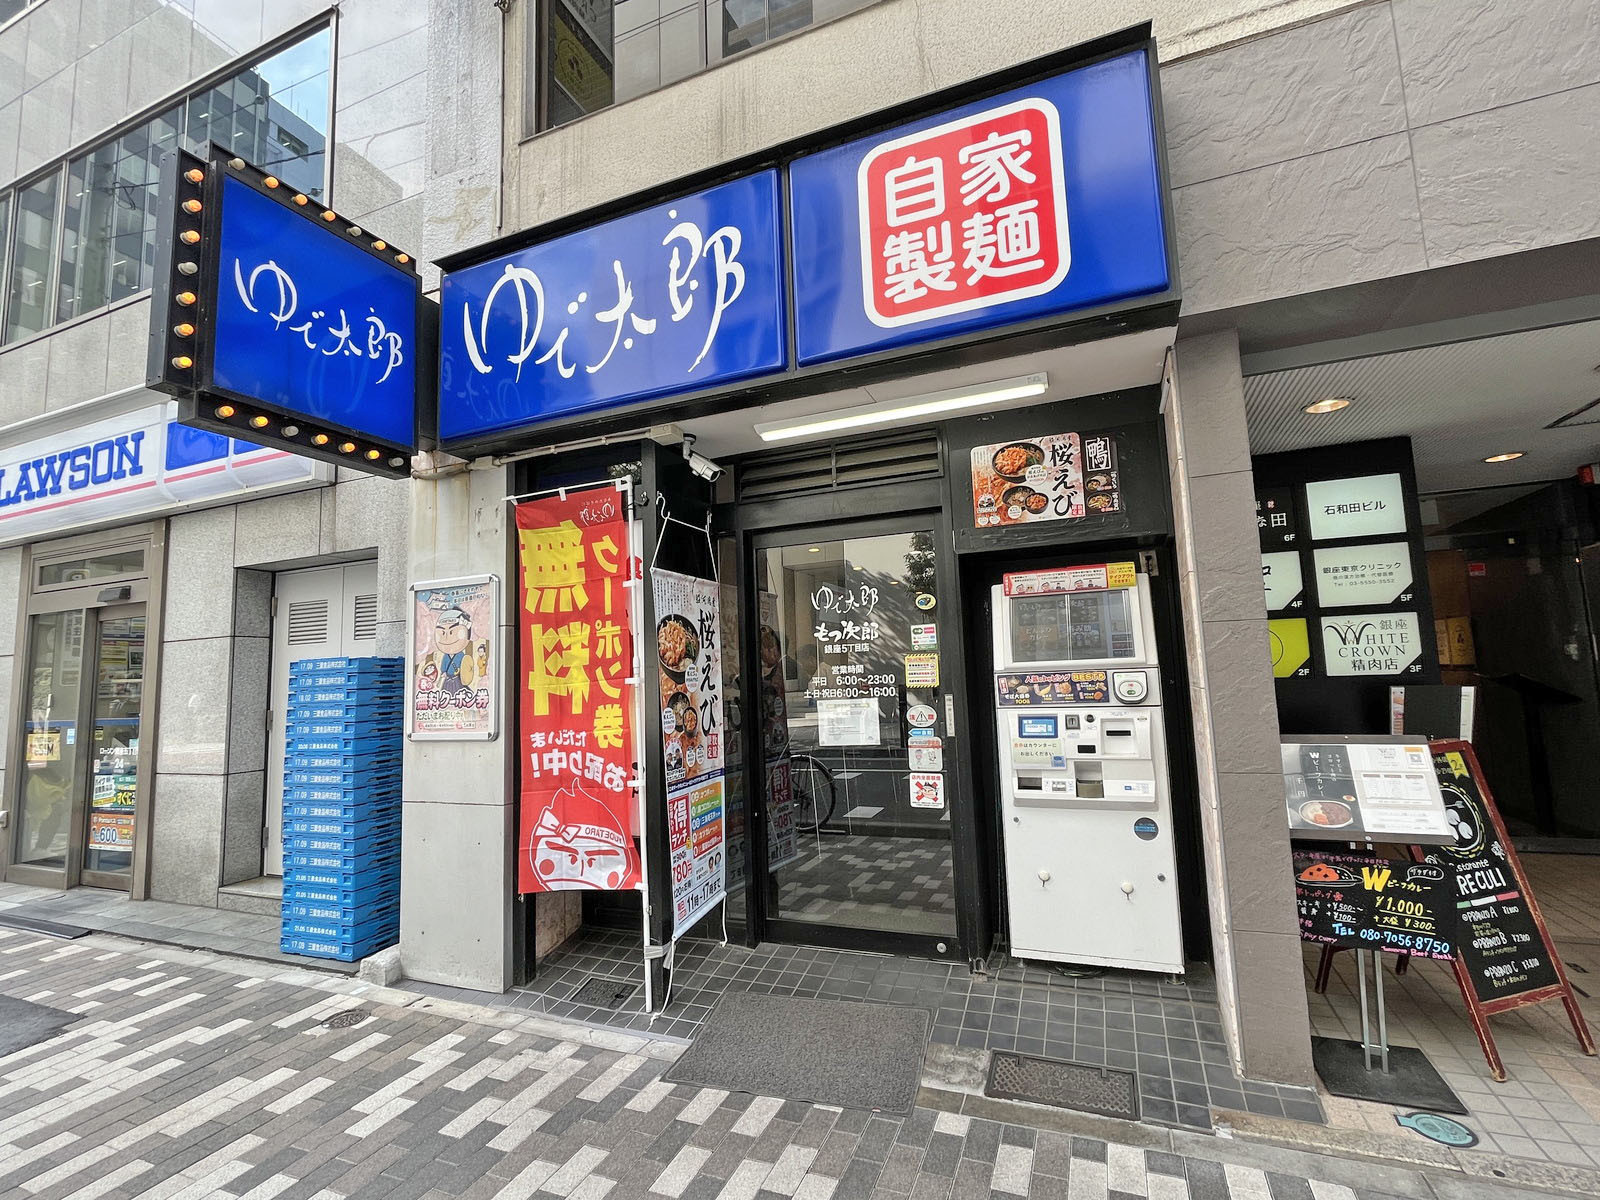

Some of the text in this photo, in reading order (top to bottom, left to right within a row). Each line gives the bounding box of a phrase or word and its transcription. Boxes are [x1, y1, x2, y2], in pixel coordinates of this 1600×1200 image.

[884, 130, 1037, 227] 自家
[882, 199, 1045, 304] 製麺
[464, 208, 746, 384] ゆで太郎
[234, 257, 404, 385] ゆで太郎
[0, 430, 145, 507] LAWSON
[1048, 442, 1078, 517] 桜えび
[1323, 500, 1386, 516] 石和田ビル
[1284, 534, 1295, 542] 6F
[1322, 562, 1401, 574] 銀座東京クリニック
[811, 582, 879, 616] ゆで太郎
[1291, 600, 1303, 608] 4F
[1400, 594, 1412, 602] 5F
[813, 620, 879, 643] もつ次郎
[1379, 618, 1408, 631] 銀座
[824, 643, 870, 654] 銀座5丁目店
[1338, 645, 1407, 659] CROWN
[831, 664, 865, 675] 営業時間
[1350, 657, 1399, 672] 精肉店
[1409, 665, 1422, 673] 3F
[698, 608, 719, 738] 桜えび
[811, 676, 828, 687] 平日
[415, 688, 490, 710] 無料クーポン券
[673, 799, 688, 832] 得
[99, 826, 117, 843] 600
[671, 828, 688, 848] ランチ
[1332, 923, 1355, 936] TEL
